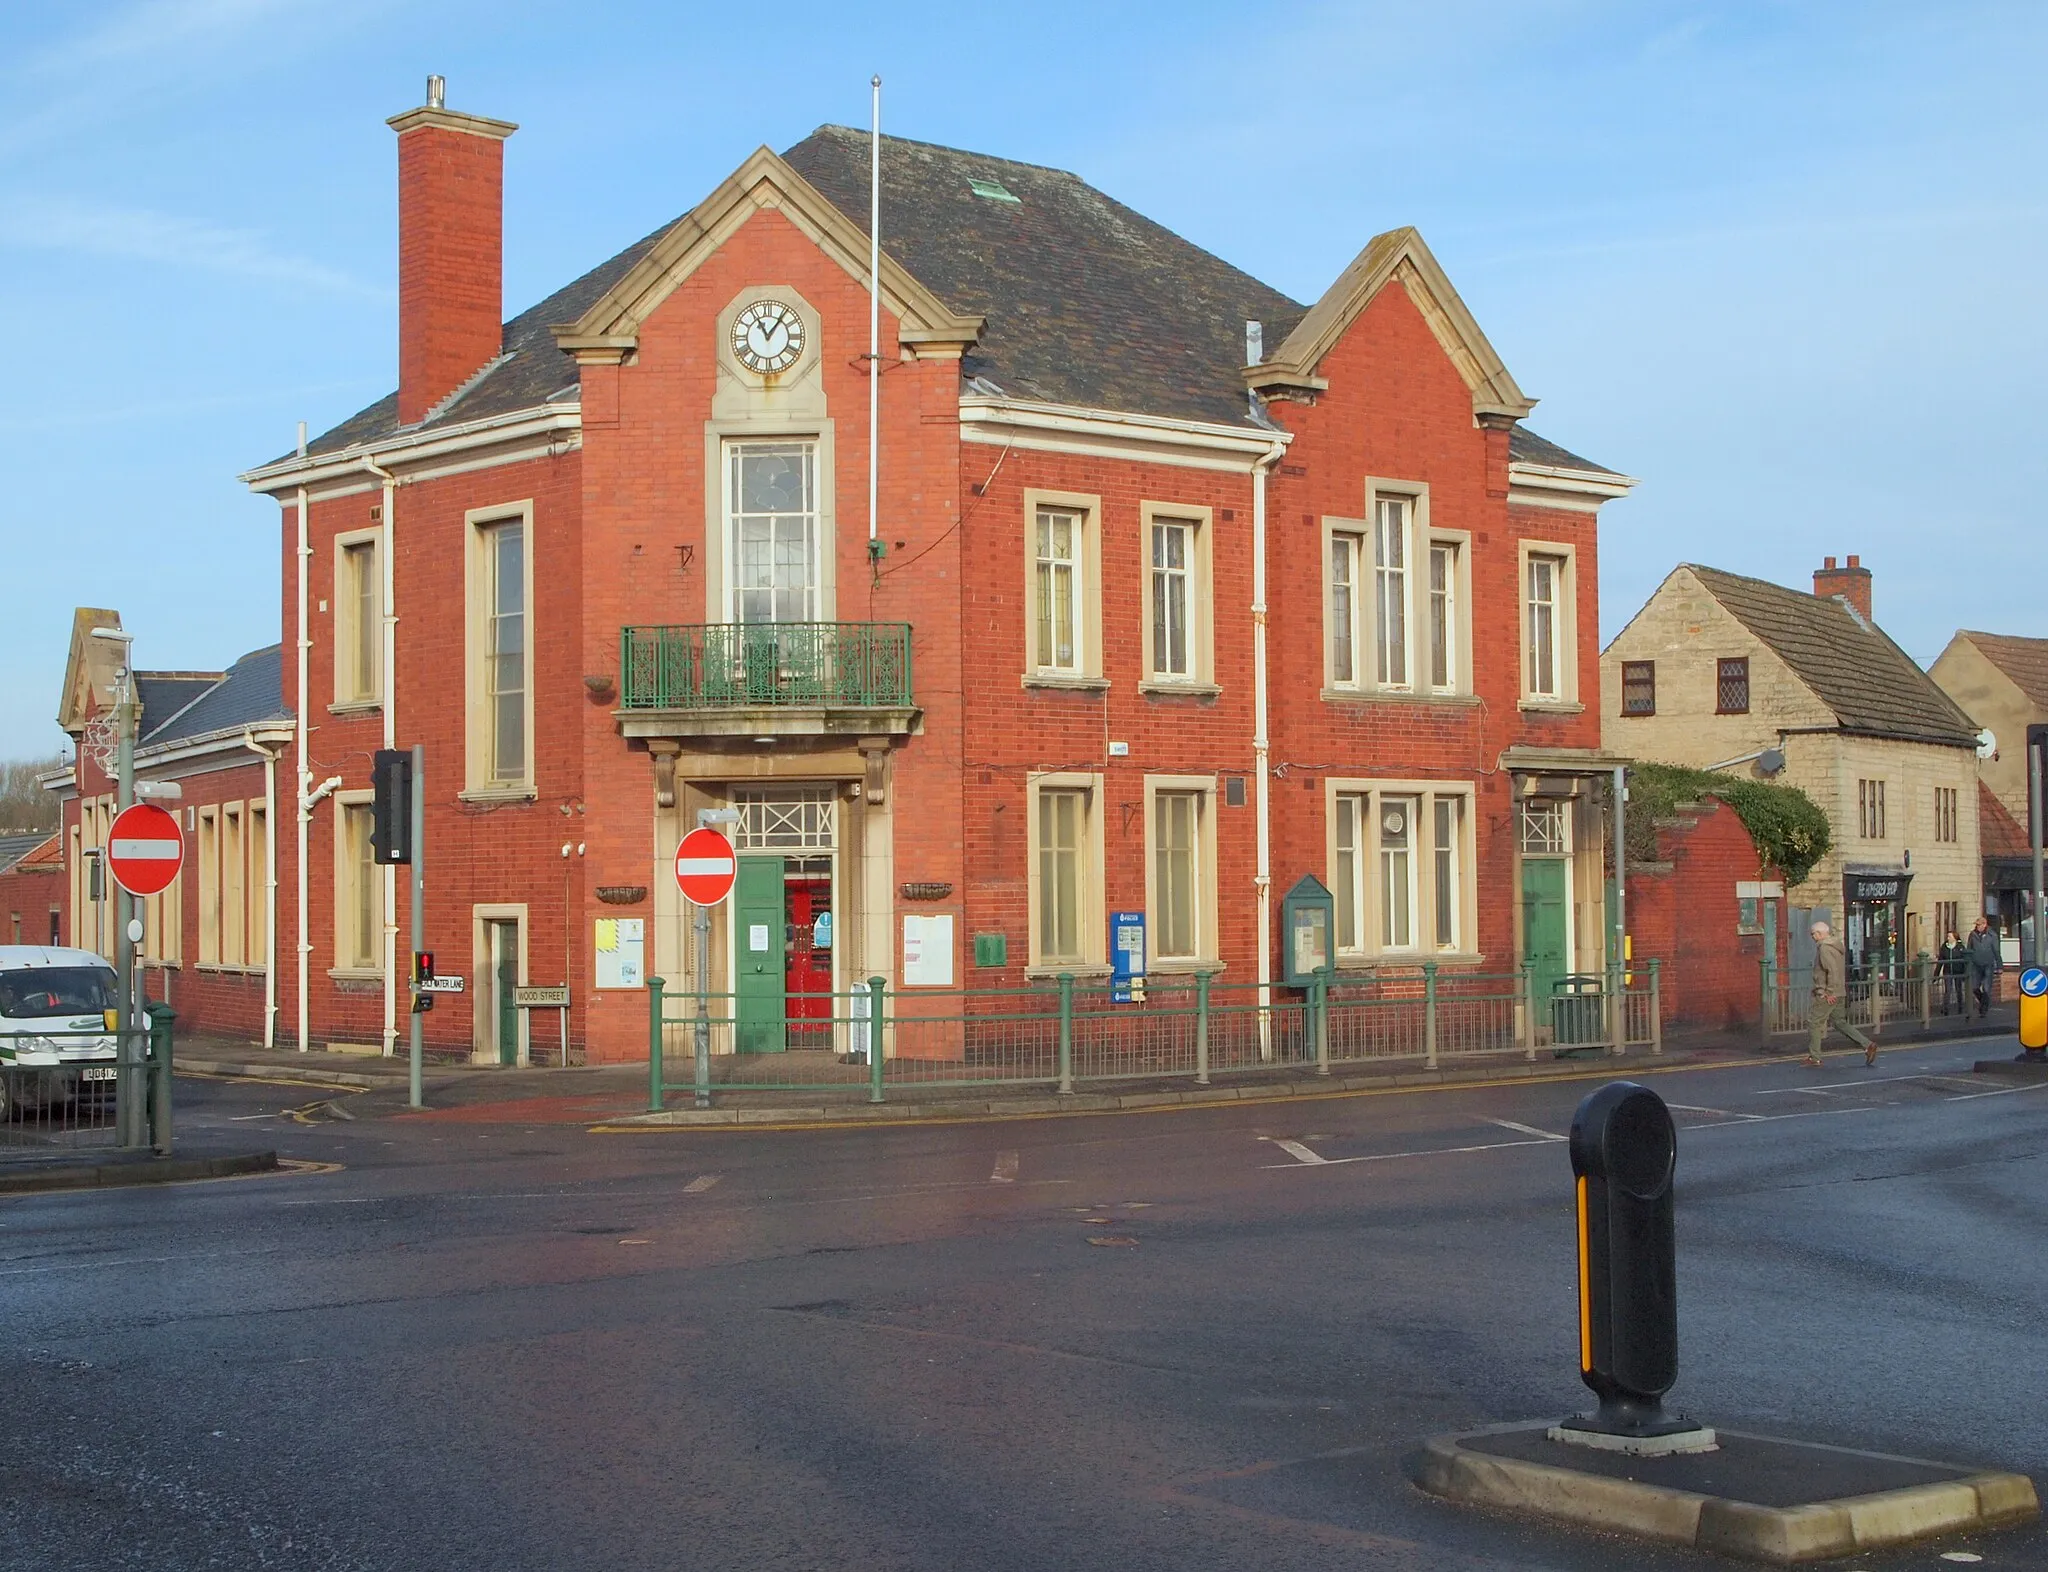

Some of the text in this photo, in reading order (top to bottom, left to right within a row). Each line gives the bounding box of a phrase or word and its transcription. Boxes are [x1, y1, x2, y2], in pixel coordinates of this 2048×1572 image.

[450, 979, 464, 988] LANE
[517, 991, 565, 1001] WOOD STREET
